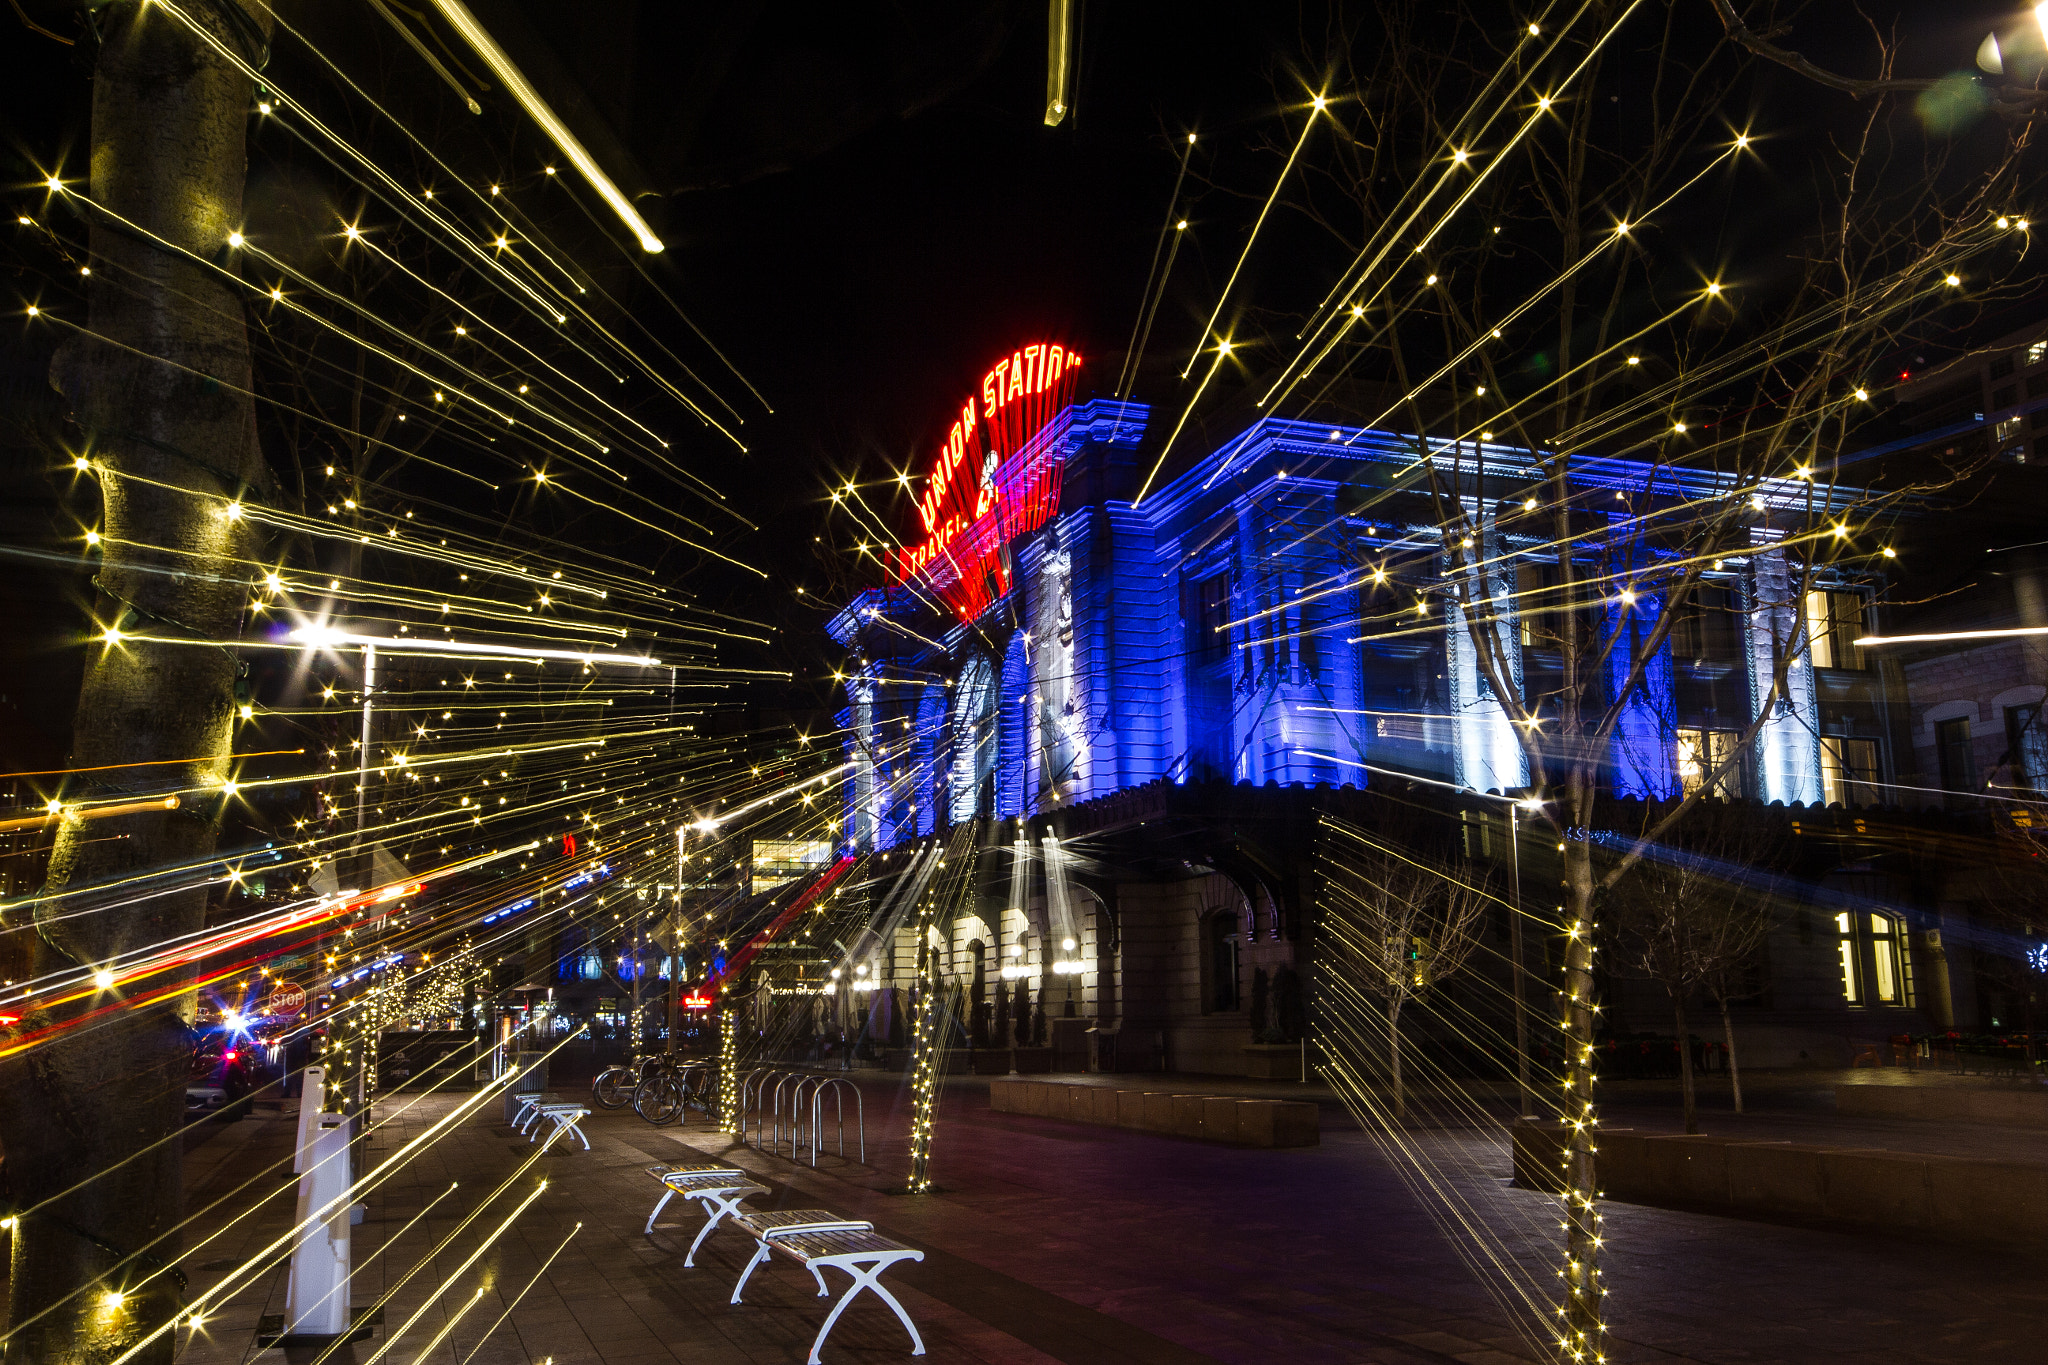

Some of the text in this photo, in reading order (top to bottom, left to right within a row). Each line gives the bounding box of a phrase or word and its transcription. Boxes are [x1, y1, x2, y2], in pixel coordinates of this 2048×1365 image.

[921, 344, 1082, 533] UNION STATIO
[796, 987, 835, 996] Resourc
[272, 993, 304, 1006] STOP
